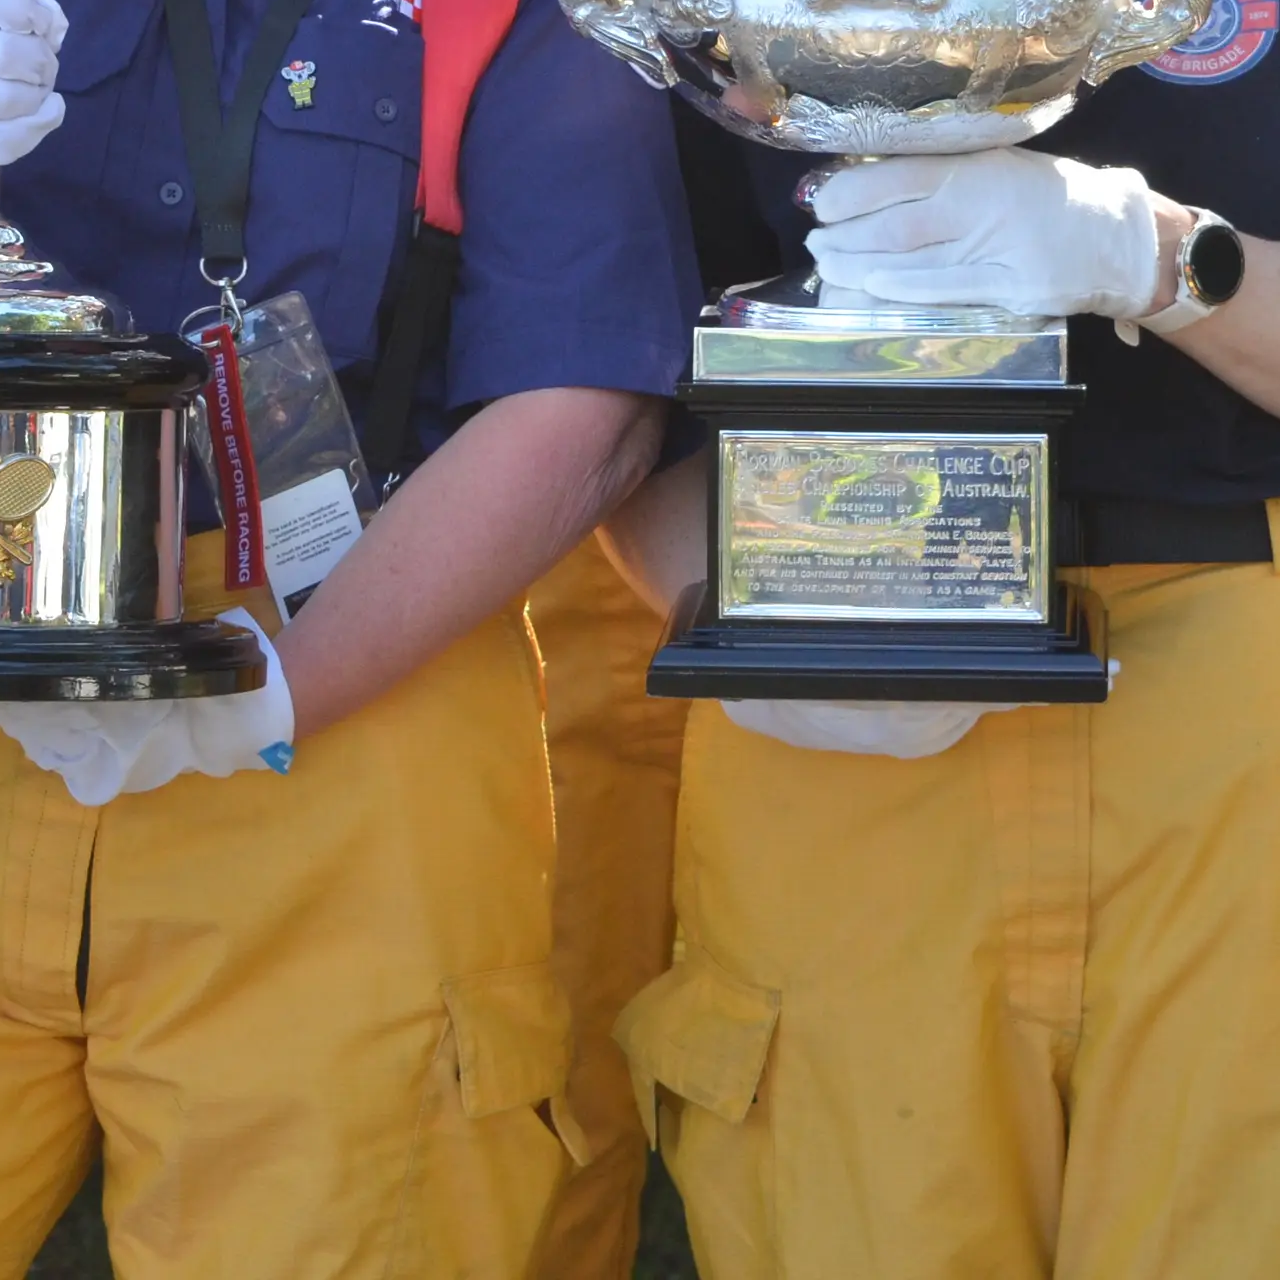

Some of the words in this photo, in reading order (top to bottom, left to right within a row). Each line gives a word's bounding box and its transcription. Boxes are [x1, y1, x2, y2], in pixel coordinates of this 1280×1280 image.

[1156, 52, 1180, 68] IRE
[1182, 44, 1246, 71] BRIGADE
[214, 353, 234, 432] REMOVE
[223, 434, 249, 509] BEFORE
[989, 454, 1030, 477] CUP
[896, 503, 913, 514] BY
[851, 514, 892, 526] TENNIS
[237, 512, 253, 584] RACING
[741, 553, 812, 566] AUSTRALIAN
[815, 554, 855, 567] TENNIS
[858, 556, 873, 567] AS
[876, 556, 892, 567] AN
[733, 568, 756, 578] AND
[746, 583, 760, 592] TO
[791, 583, 866, 593] DEVELOPMENT
[937, 586, 950, 595] AS
[954, 586, 962, 595] A
